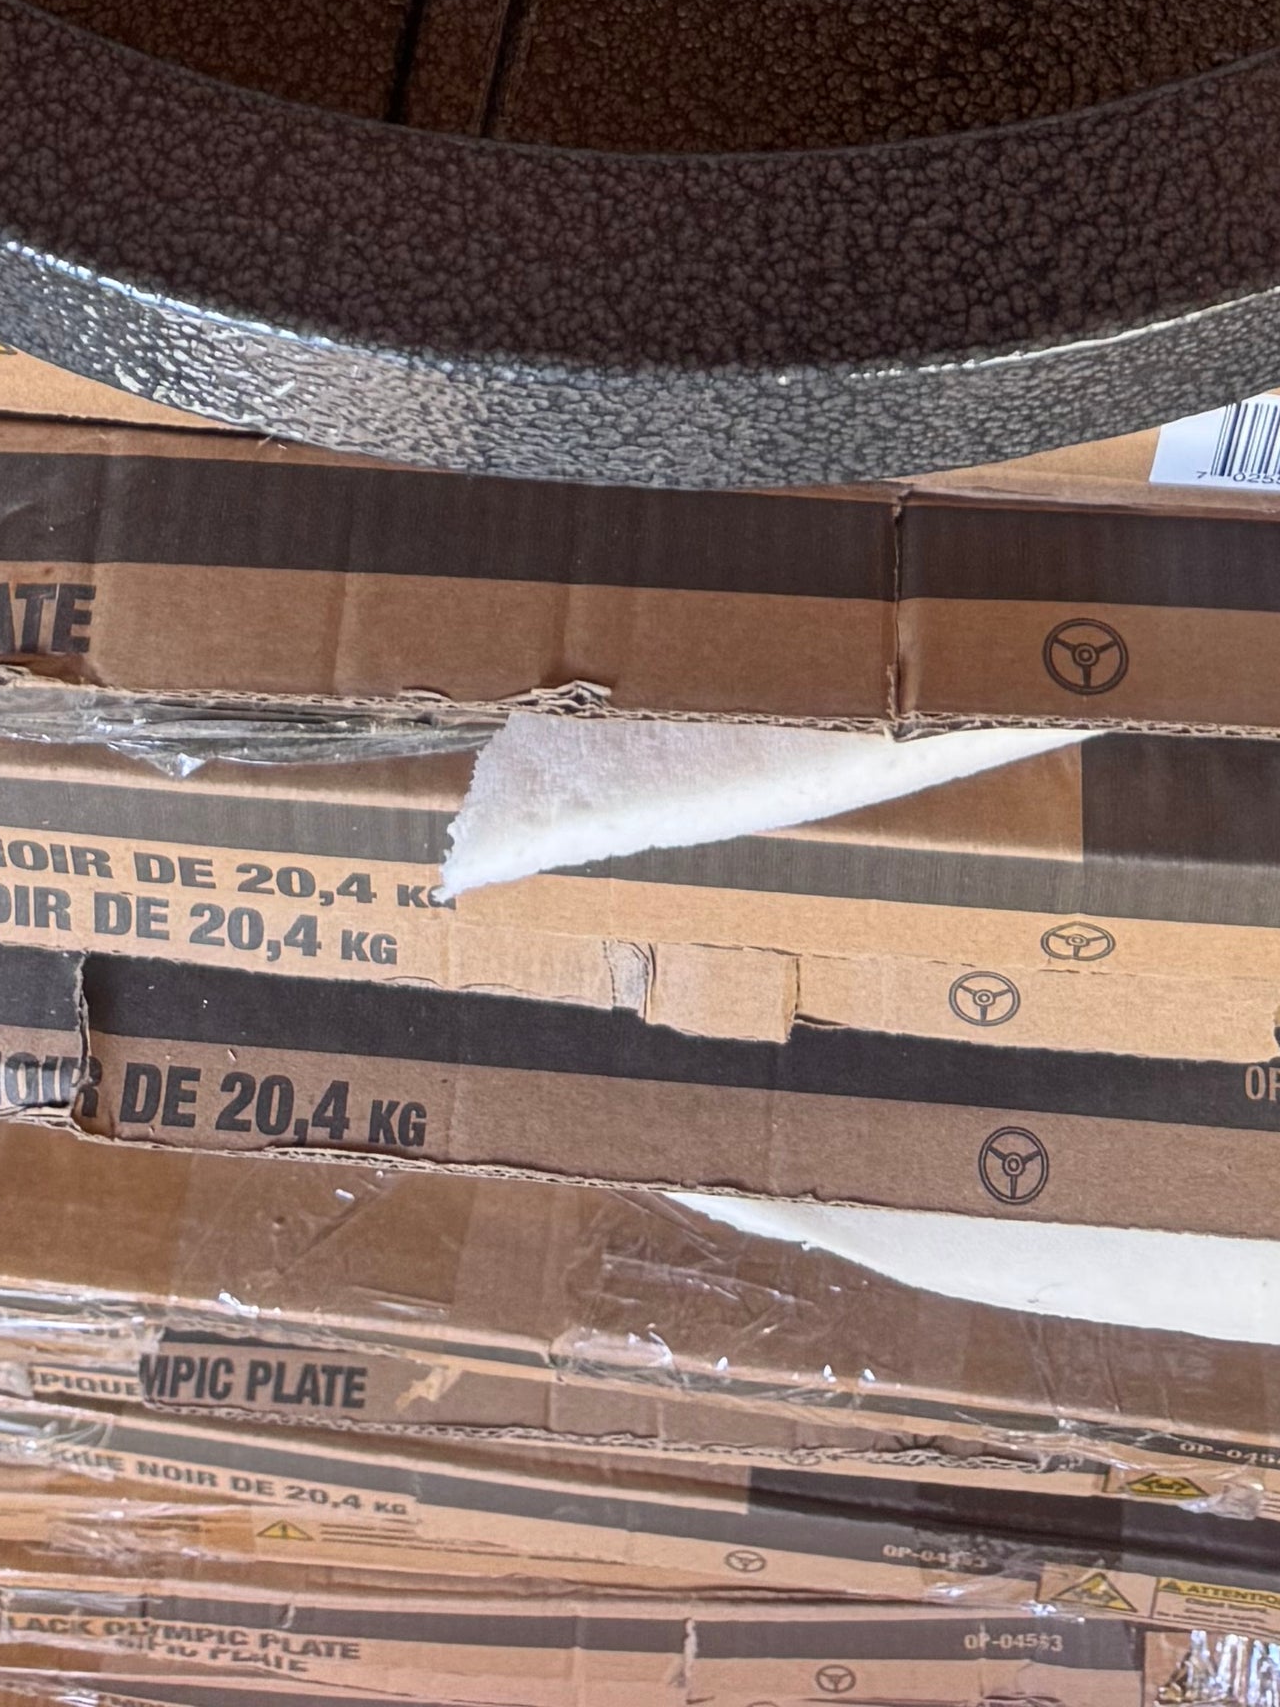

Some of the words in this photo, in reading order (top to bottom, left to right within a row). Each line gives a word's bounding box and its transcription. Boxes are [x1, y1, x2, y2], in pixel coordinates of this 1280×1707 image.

[1196, 470, 1208, 480] 7
[133, 851, 218, 890] DE
[235, 862, 378, 908] 20,4
[93, 890, 171, 941] DE
[189, 902, 323, 963] 20,4
[340, 928, 399, 966] KG
[118, 1061, 204, 1132] DE
[215, 1071, 352, 1145] 20,4
[367, 1098, 430, 1149] KG
[139, 1353, 235, 1402] MPIC
[245, 1358, 368, 1410] PLATE
[136, 1460, 219, 1489] NOIR
[228, 1475, 276, 1498] DE
[373, 1500, 410, 1517] KG
[102, 1620, 249, 1647] OLYMPIC
[259, 1632, 361, 1660] PLATE
